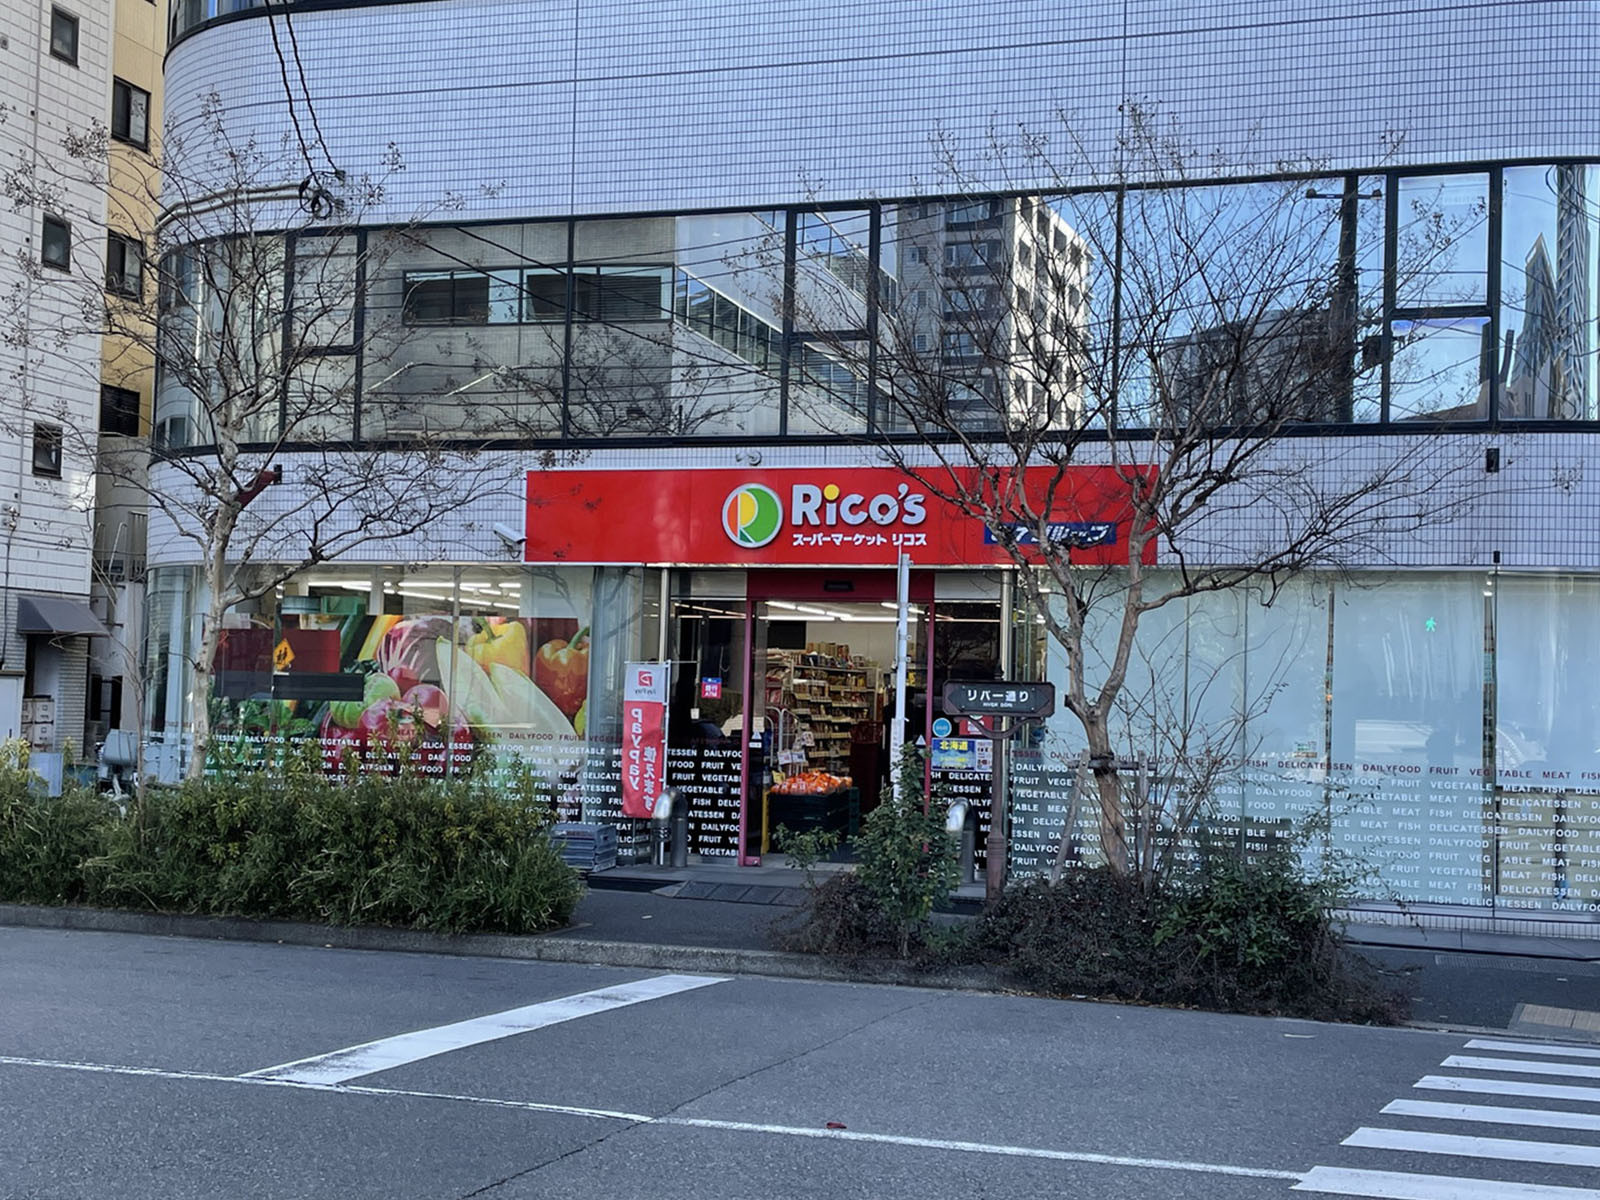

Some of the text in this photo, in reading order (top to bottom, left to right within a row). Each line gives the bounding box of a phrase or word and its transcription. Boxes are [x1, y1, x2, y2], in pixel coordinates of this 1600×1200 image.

[791, 483, 926, 526] Rico's
[793, 533, 927, 546] スーパーマーケット リコス
[968, 689, 1029, 702] リバー通り
[587, 759, 605, 767] FISH
[701, 761, 724, 769] FRUIT
[672, 772, 695, 781] FRUIT
[1278, 761, 1352, 771] DELICATESSEN
[1363, 763, 1421, 773] DAILYFOOD
[1429, 766, 1459, 775] FRUIT
[1543, 771, 1571, 779] MEAT
[1013, 776, 1039, 785] FRUIT
[1391, 778, 1420, 788] FRUIT
[1430, 781, 1492, 791] VEGETABLE
[557, 783, 616, 793] DELICATESSEN
[692, 798, 711, 806] FISH
[1429, 795, 1458, 804] MEAT
[1468, 796, 1492, 805] FISH
[1502, 798, 1581, 809] DELICATESSEN
[1392, 807, 1420, 817] MEAT
[1429, 808, 1453, 818] FISH
[1463, 810, 1542, 822] DELICATESSEN
[1253, 815, 1282, 825] FRUIT
[1361, 819, 1389, 829] MEAT
[1398, 820, 1421, 831] FISH
[1429, 823, 1508, 834] DELICATESSEN
[1518, 827, 1579, 838] DAILYFOOD
[698, 834, 722, 843] FRUIT
[1344, 834, 1421, 845] DELICATESSEN
[1429, 837, 1489, 848] DAILYFOOD
[1500, 841, 1530, 850] FRUIT
[1429, 852, 1459, 861] FRUIT
[1542, 857, 1571, 867] MEAT
[1390, 864, 1420, 874] FRUIT
[1430, 866, 1492, 878] VEGETABLE
[1502, 870, 1531, 879] MEAT
[1541, 872, 1566, 881] FISH
[1429, 880, 1458, 890] MEAT
[1467, 883, 1491, 892] FISH
[1501, 884, 1581, 897] DELICATESSEN
